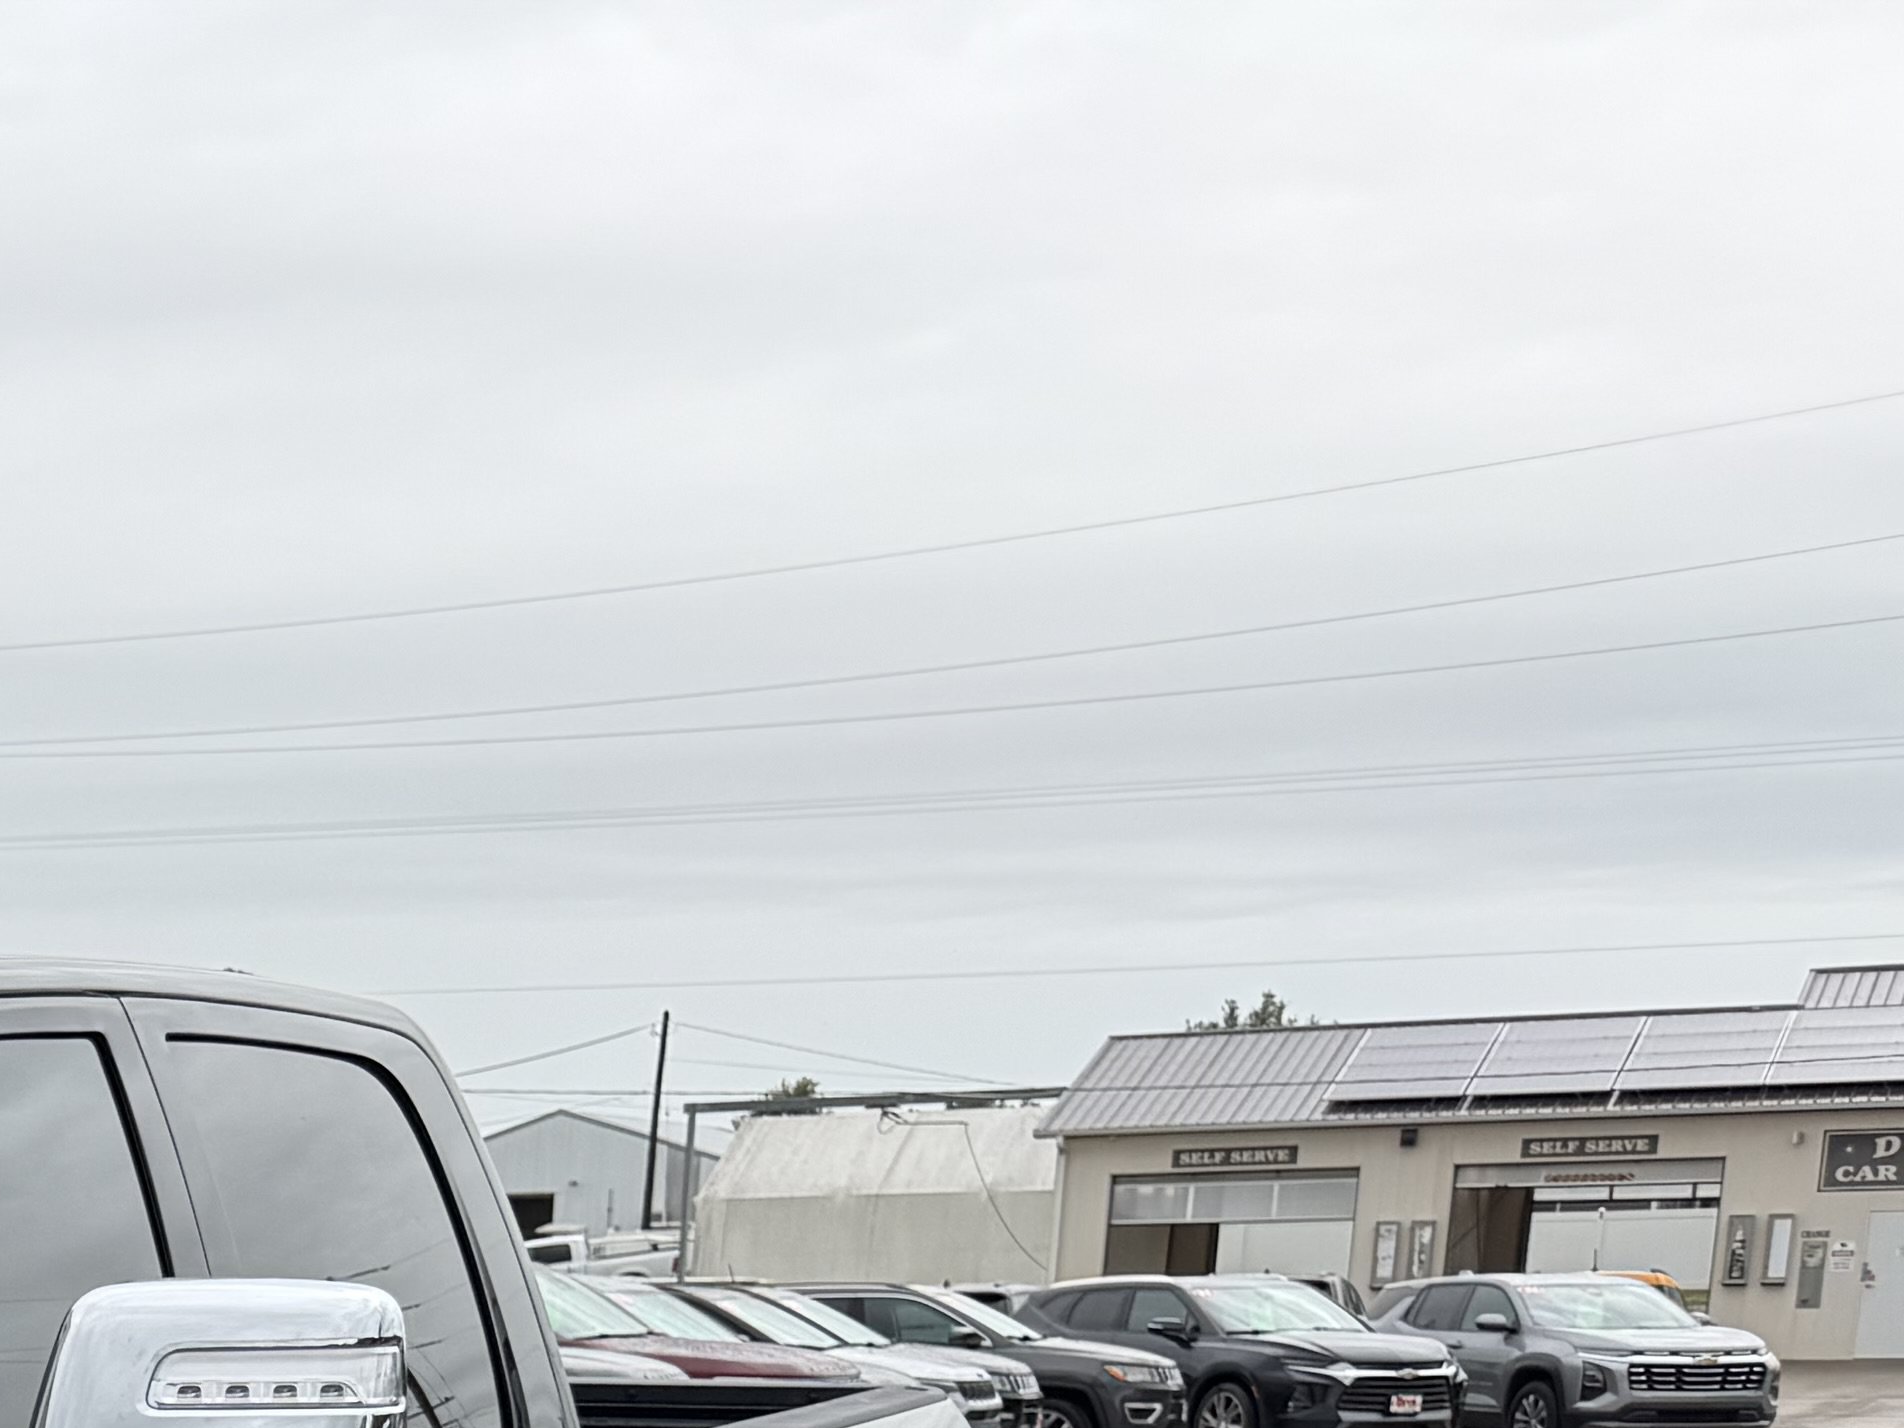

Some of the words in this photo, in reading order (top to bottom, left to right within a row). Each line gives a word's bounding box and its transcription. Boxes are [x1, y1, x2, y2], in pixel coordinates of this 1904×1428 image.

[1528, 1140, 1580, 1155] SELF
[1584, 1138, 1650, 1153] SERVE
[1178, 1151, 1226, 1165] SELF
[1229, 1148, 1290, 1163] SERVE
[1834, 1165, 1897, 1182] CAR
